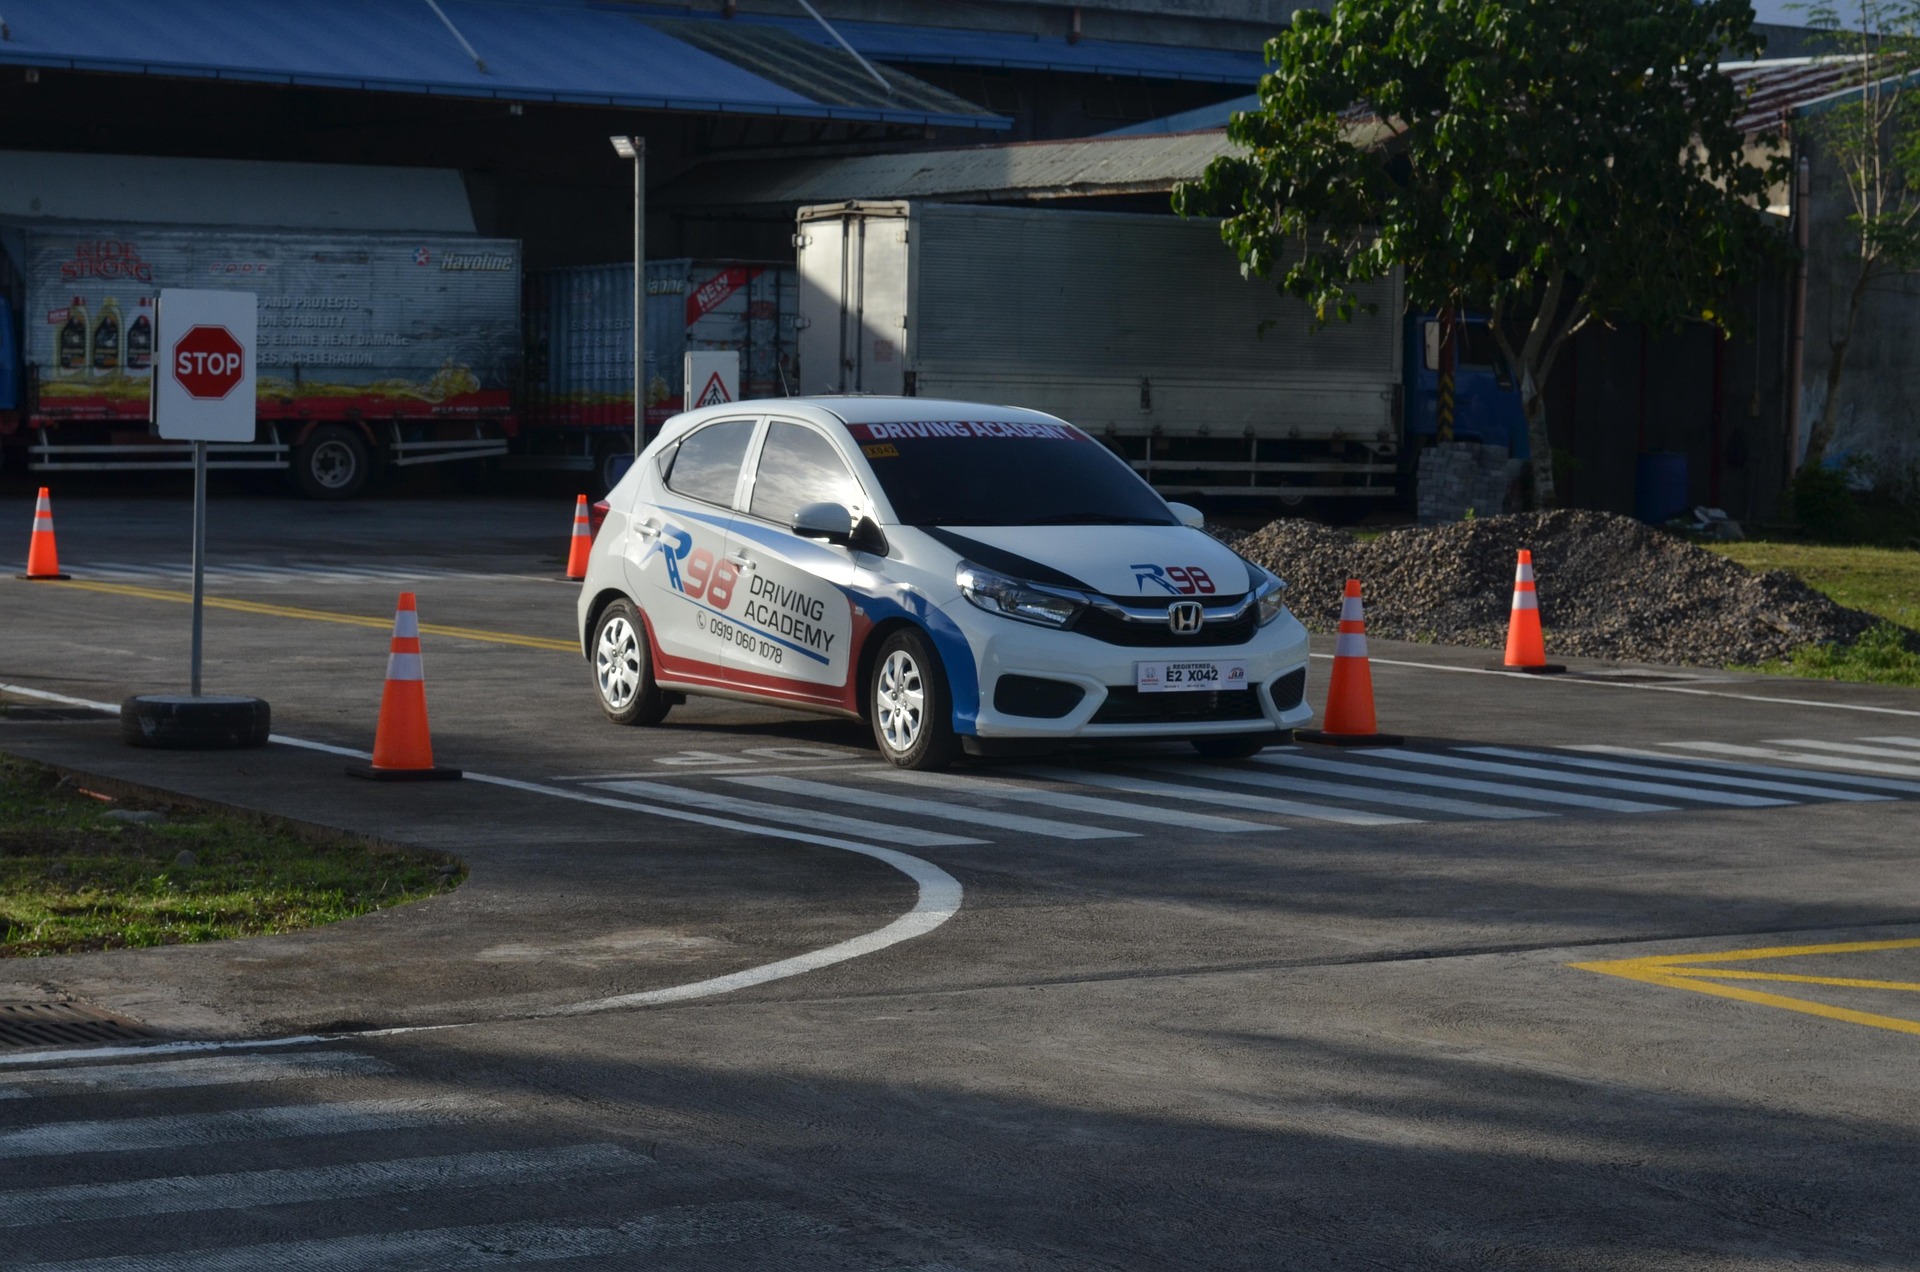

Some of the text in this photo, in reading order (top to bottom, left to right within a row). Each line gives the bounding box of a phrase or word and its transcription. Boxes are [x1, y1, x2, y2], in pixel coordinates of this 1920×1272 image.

[60, 259, 153, 283] STRONG
[440, 252, 513, 272] Havoline
[696, 273, 729, 306] NEW
[264, 297, 290, 309] AND
[296, 297, 359, 310] PROTECTS
[282, 315, 345, 328] STABILITY
[273, 334, 320, 346] ENGINE
[321, 334, 353, 346] HEAT
[177, 352, 241, 376] STOP
[867, 421, 1074, 440] DRIVING ACADEMY
[1130, 563, 1216, 595] R98
[750, 574, 825, 622] DRIVING
[744, 600, 835, 653] ACADEMY
[710, 618, 783, 664] 0919 060 1078
[1166, 669, 1219, 682] E2 X042
[1172, 663, 1211, 671] REGISTERED
